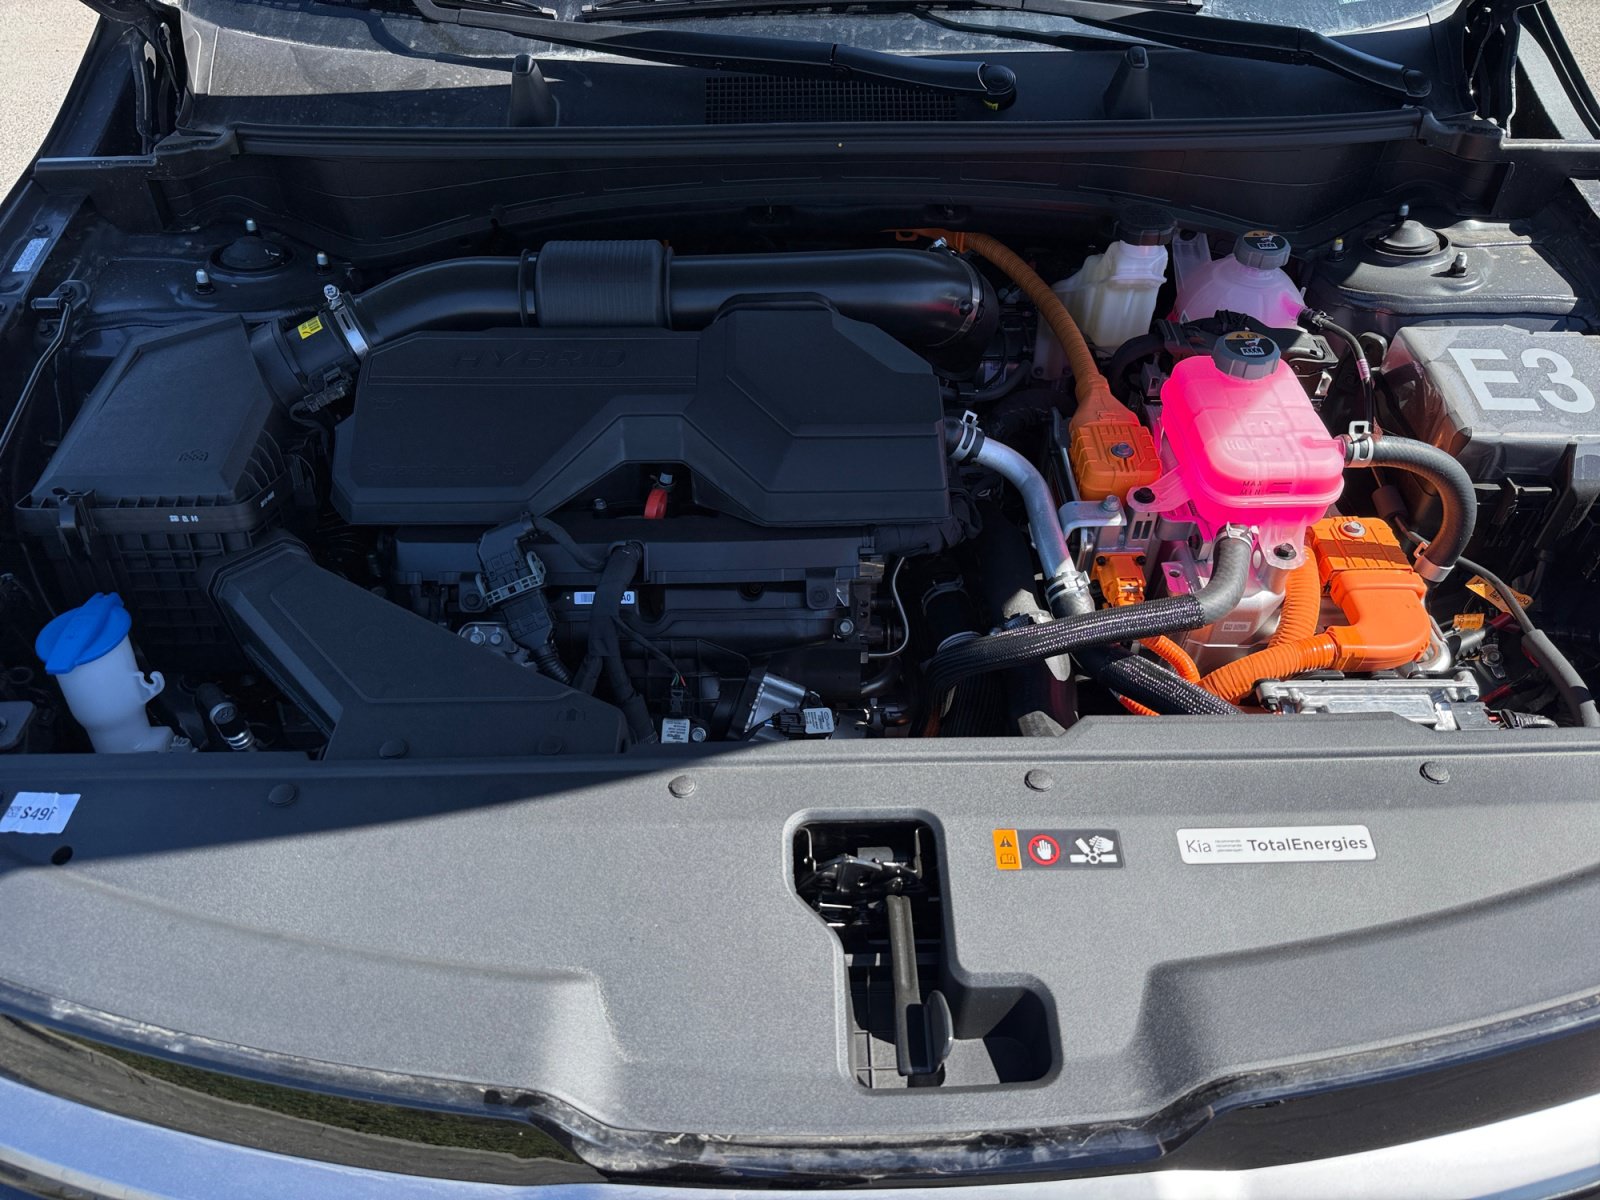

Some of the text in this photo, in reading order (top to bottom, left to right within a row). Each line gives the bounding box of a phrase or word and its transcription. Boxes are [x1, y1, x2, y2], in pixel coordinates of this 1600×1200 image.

[450, 350, 627, 369] HYBRID
[1447, 347, 1596, 414] E3
[1185, 836, 1368, 853] Kia TotalEnergies
